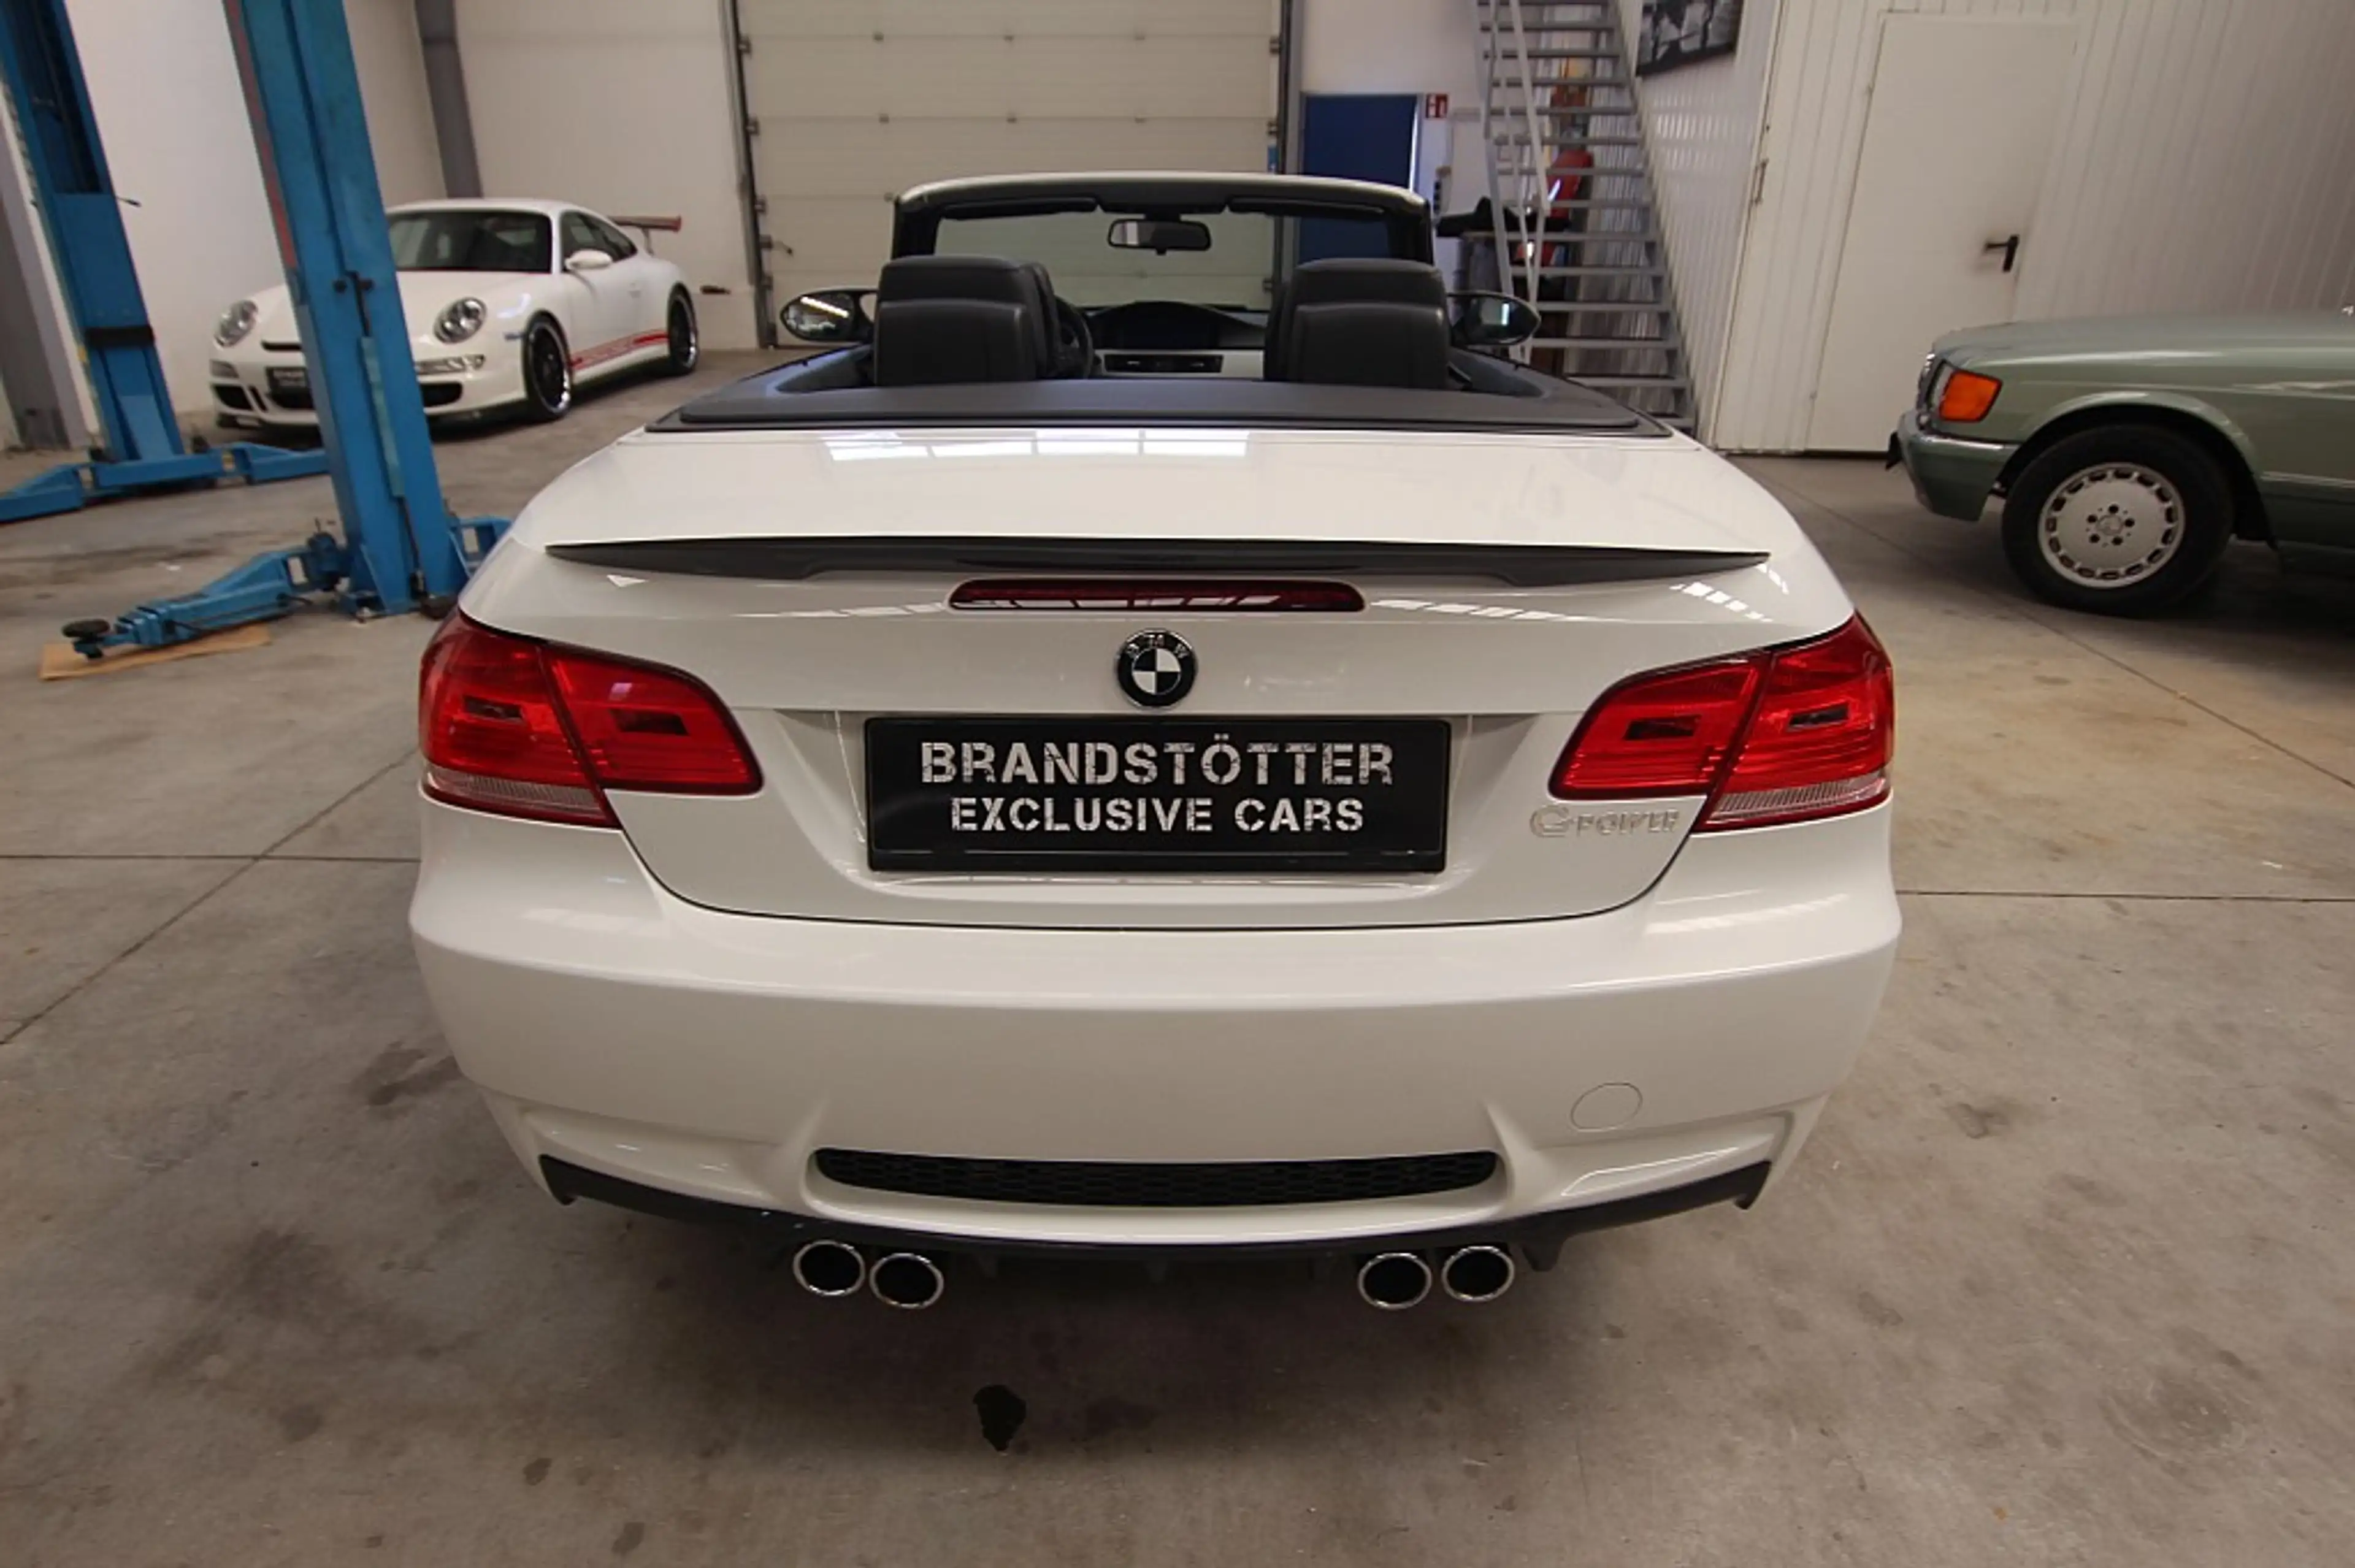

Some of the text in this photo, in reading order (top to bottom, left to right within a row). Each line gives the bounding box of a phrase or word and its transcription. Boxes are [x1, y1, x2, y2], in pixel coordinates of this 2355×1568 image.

[921, 733, 1393, 786] BRANDSTÖTTER
[951, 797, 1363, 832] EXCLUSIVE CARS
